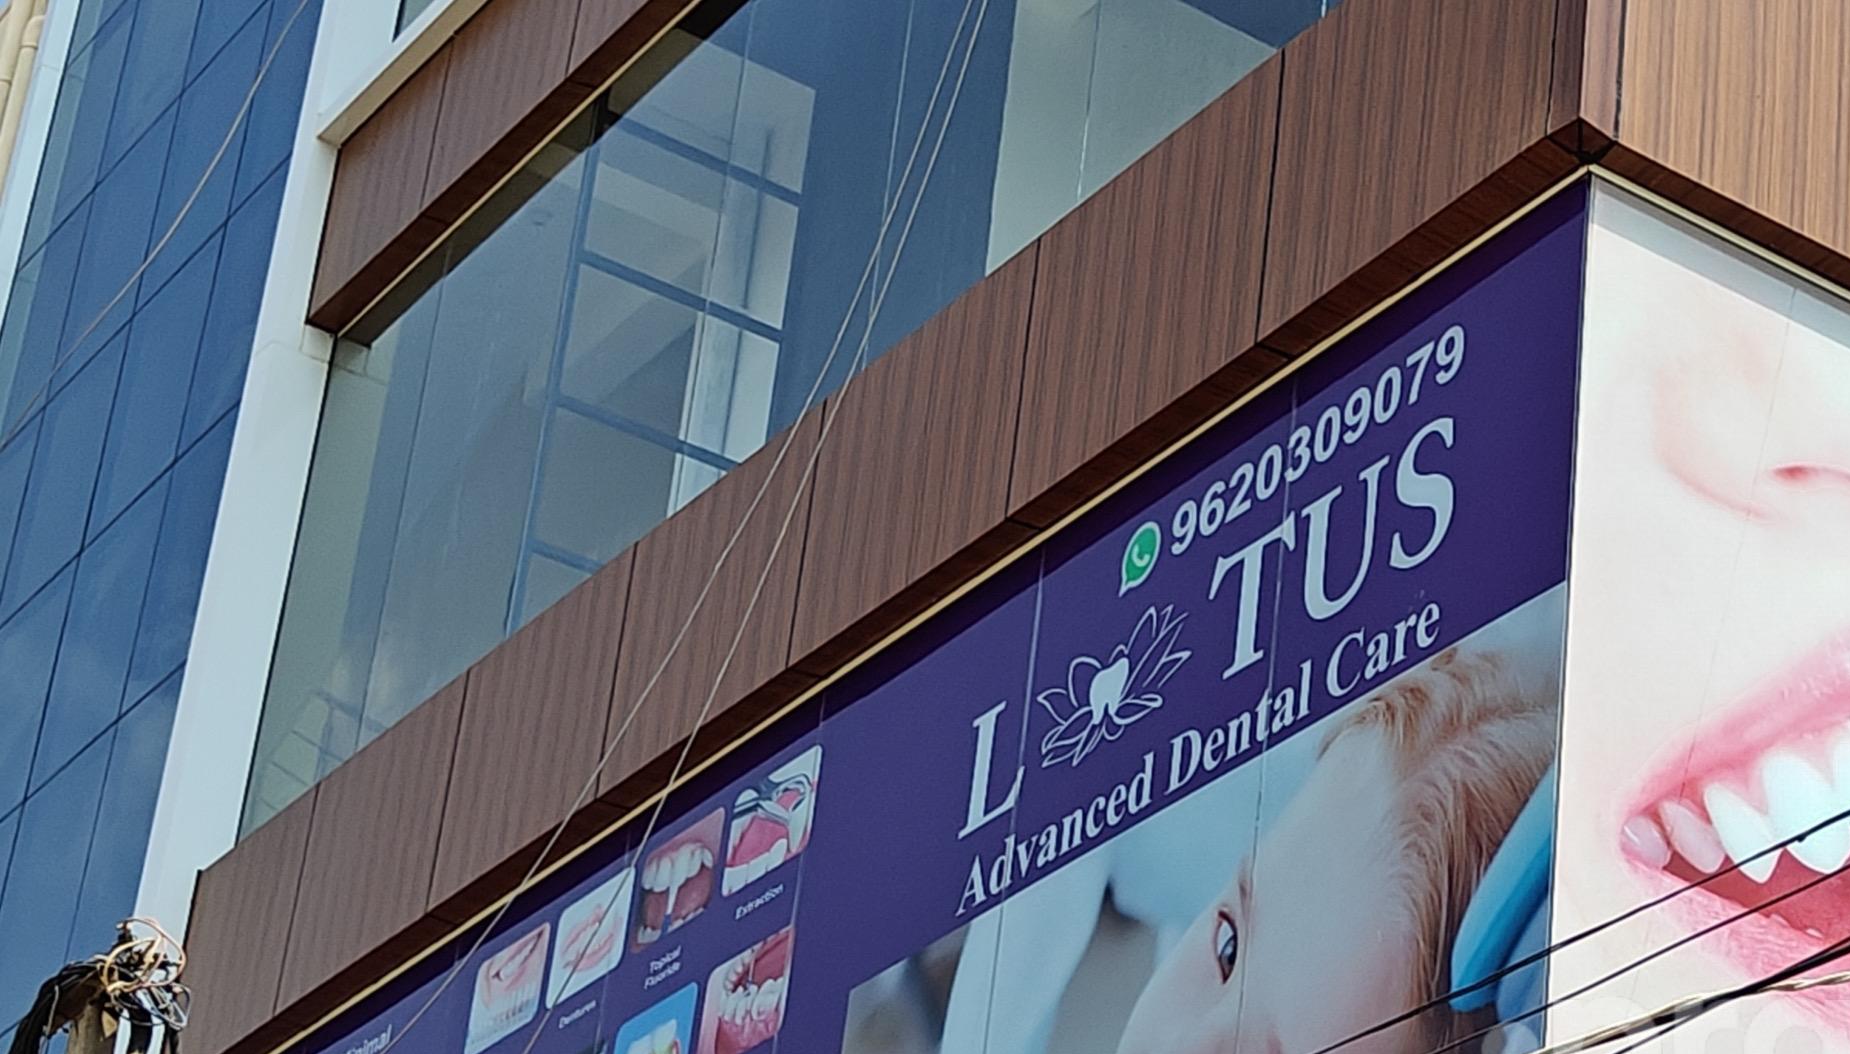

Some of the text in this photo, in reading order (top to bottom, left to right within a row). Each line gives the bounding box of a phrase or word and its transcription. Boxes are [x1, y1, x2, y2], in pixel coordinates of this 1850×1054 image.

[1169, 323, 1467, 556] 9620309079
[954, 600, 1442, 918] Advanced Dental Care
[734, 883, 784, 921] Extraction
